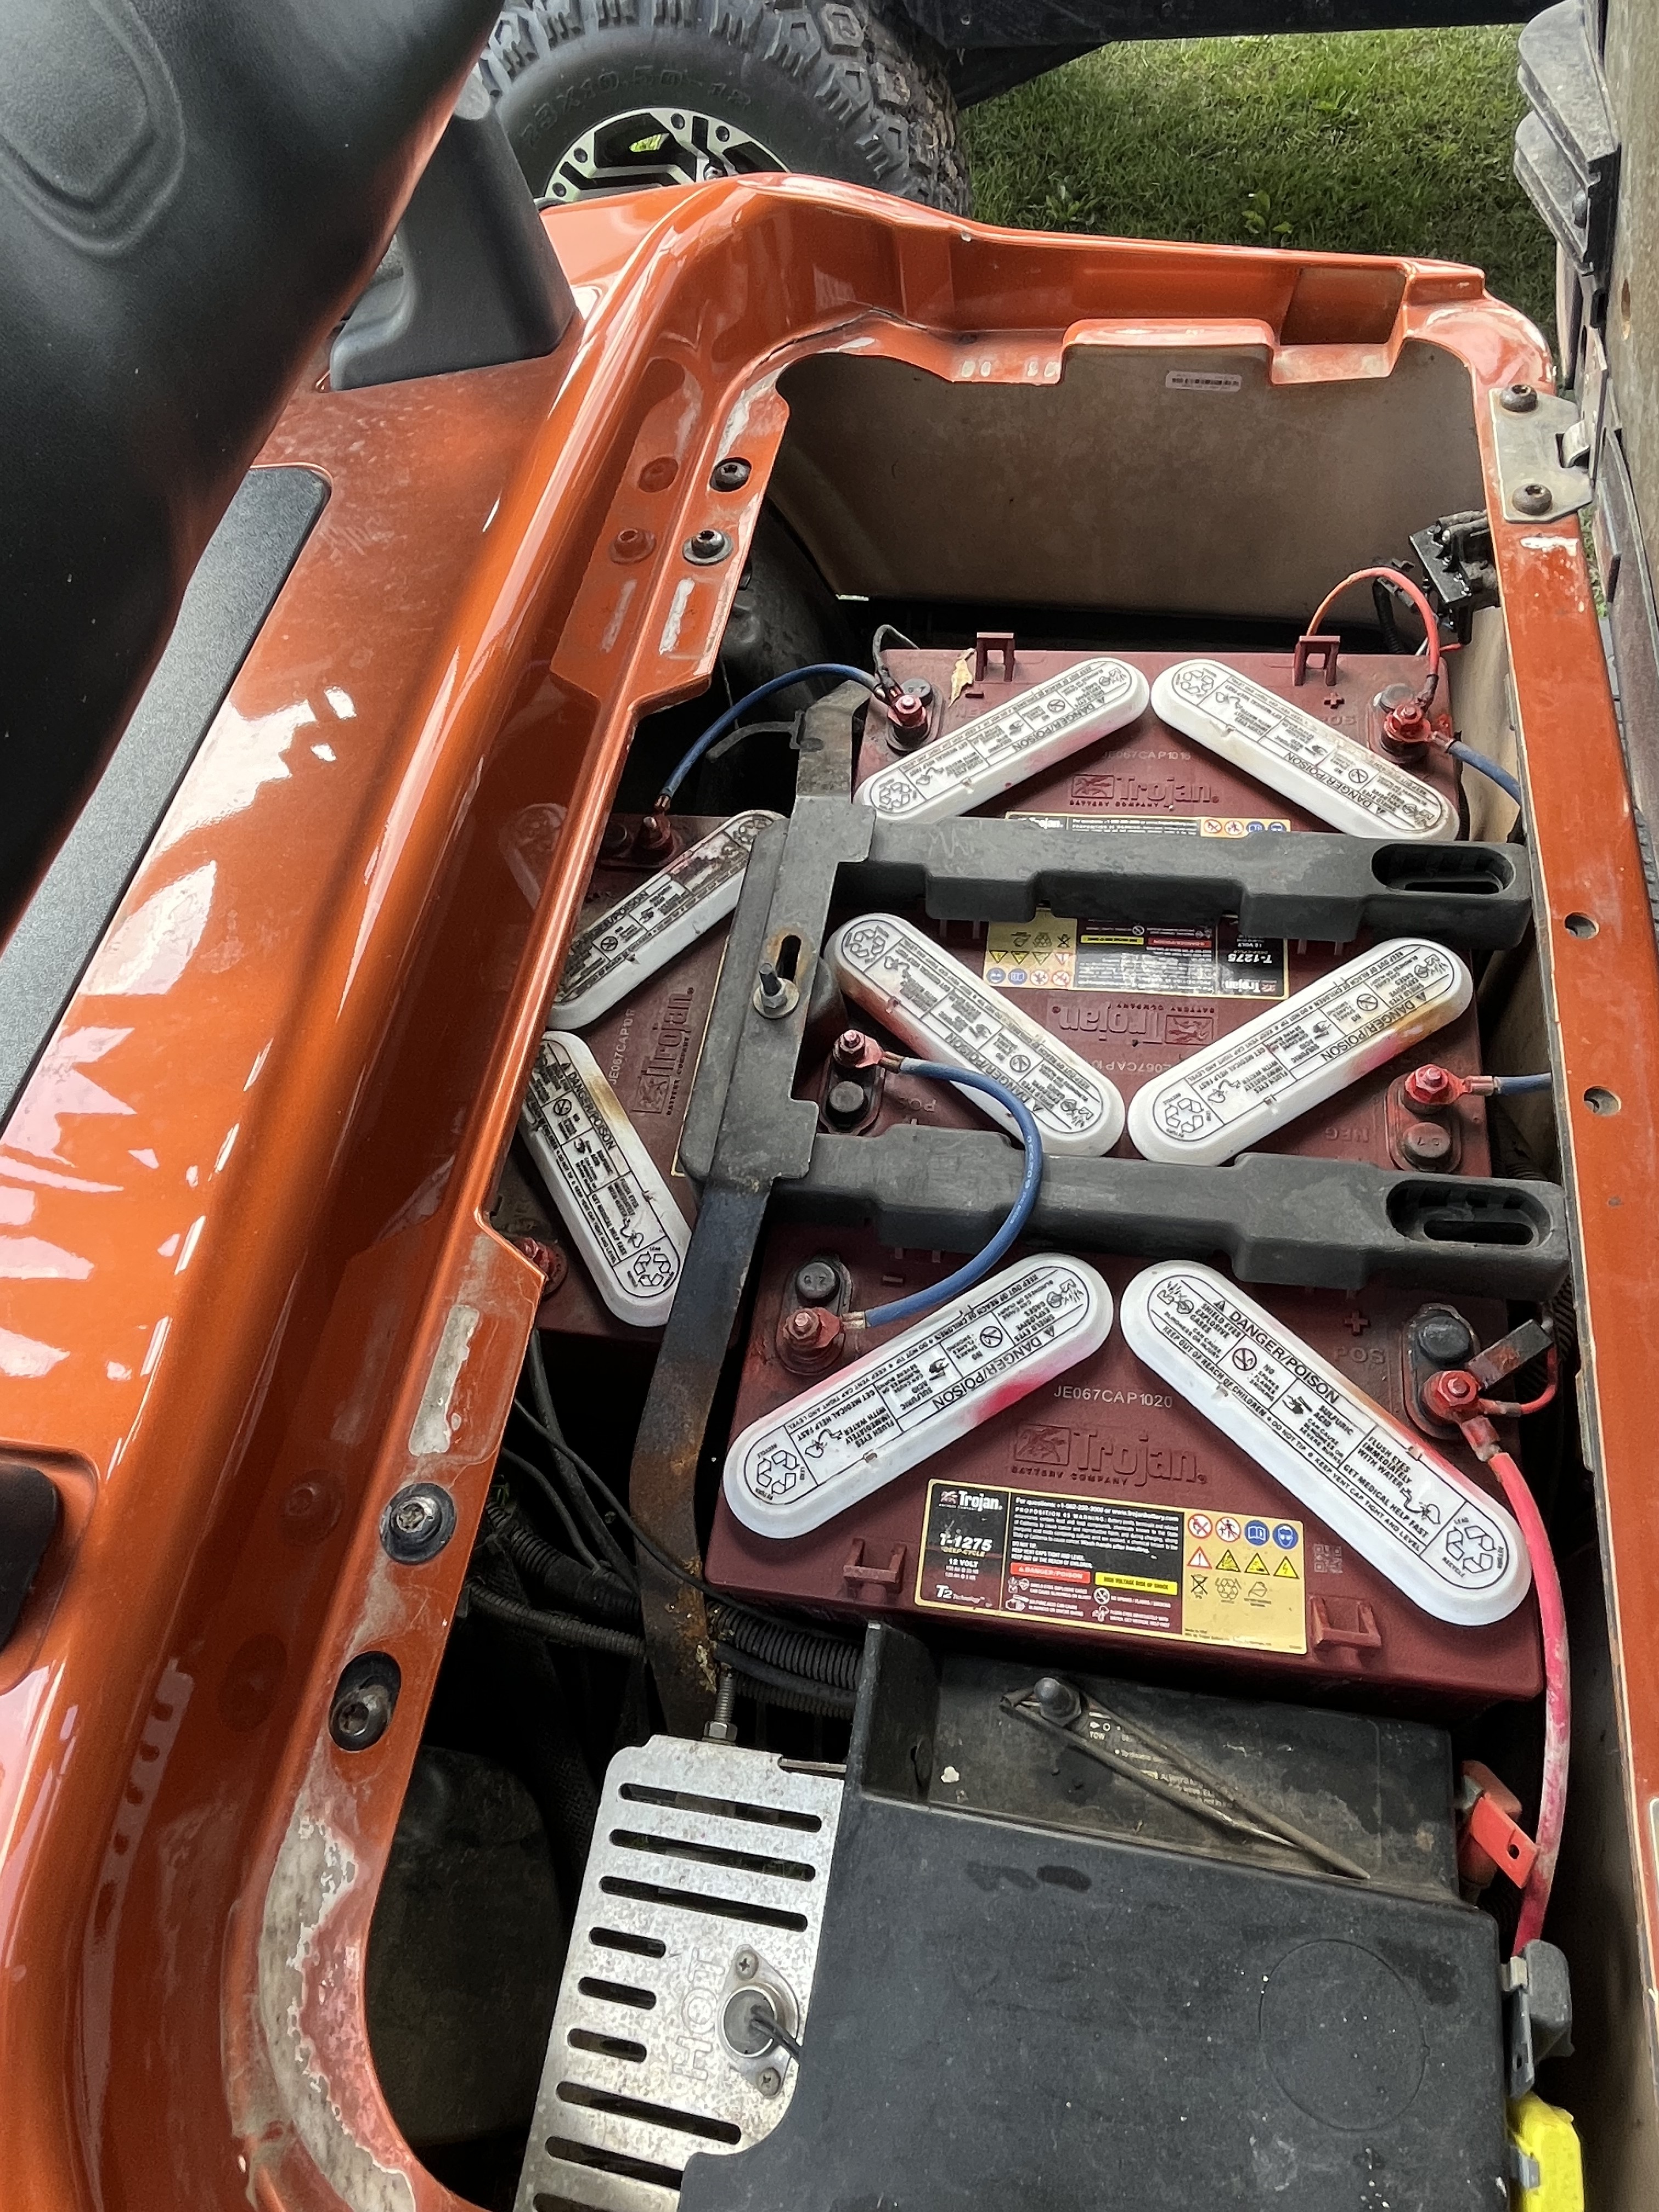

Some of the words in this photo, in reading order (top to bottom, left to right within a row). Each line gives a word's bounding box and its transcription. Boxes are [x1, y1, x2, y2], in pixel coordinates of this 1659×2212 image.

[1012, 701, 1094, 753] DANGER/POISON
[1283, 751, 1372, 809] DANGER/POISON
[1115, 774, 1211, 810] Trojan
[1228, 953, 1272, 963] T-1275
[1225, 978, 1260, 992] Trojan
[1059, 1000, 1163, 1044] Trojan
[1320, 999, 1415, 1062] DANGER/POISON
[643, 992, 692, 1077] Trojan
[664, 1079, 680, 1115] BATTERY
[675, 1037, 691, 1075] COMPANY
[566, 1070, 617, 1151] DANGER/POISON
[1325, 1126, 1369, 1143] NEG
[1007, 1283, 1023, 1296] OUT
[1021, 1273, 1039, 1288] KEEP
[976, 1297, 999, 1315] REACH
[998, 1292, 1009, 1302] OF
[967, 1311, 977, 1321] OF
[1015, 1306, 1051, 1331] EXPLOSIVE
[1023, 1300, 1046, 1318] GASES
[933, 1317, 968, 1341] CHILDREN
[1030, 1312, 1055, 1332] SHIELD
[1188, 1313, 1212, 1334] GASES
[1194, 1307, 1230, 1339] EXPLOSIVE
[1200, 1302, 1225, 1324] SHIELD
[1223, 1321, 1242, 1338] EYES
[1013, 1328, 1031, 1342] EYES
[905, 1347, 918, 1358] NOT
[918, 1341, 928, 1351] DO
[970, 1350, 983, 1361] NO
[1333, 1346, 1385, 1364] POS
[894, 1355, 905, 1365] TIP
[1228, 1309, 1340, 1404] DANGER/POISON
[869, 1367, 887, 1380] KEEP
[932, 1334, 1043, 1410] DANGER/POISON
[1262, 1363, 1276, 1376] NO
[853, 1376, 870, 1390] VENT
[910, 1379, 928, 1394] ACID
[1248, 1378, 1276, 1402] SMOKING
[1253, 1374, 1276, 1395] FLAMES
[1257, 1370, 1280, 1390] SPARKS
[821, 1395, 840, 1409] TIGHT
[840, 1386, 854, 1398] CAP
[861, 1388, 876, 1401] GET
[899, 1386, 933, 1411] SULFURIC
[1053, 1385, 1173, 1408] JE067CAP1020
[807, 1407, 822, 1418] AND
[831, 1396, 862, 1419] MEDICAL
[866, 1405, 887, 1421] WITH
[787, 1415, 808, 1430] LEVEL
[812, 1415, 832, 1430] HELP
[843, 1417, 867, 1436] WATER
[843, 1412, 891, 1445] IMMEDIATELY
[871, 1419, 895, 1437] FLUSH
[1312, 1410, 1332, 1428] ACID
[1318, 1404, 1355, 1436] SULFURIC
[795, 1426, 814, 1441] FAST
[854, 1432, 872, 1448] EYES
[1161, 1324, 1181, 1342] KEEP
[1177, 1339, 1193, 1353] OUT
[1191, 1350, 1203, 1361] OF
[1199, 1358, 1224, 1380] REACH
[1221, 1377, 1233, 1389] OF
[1231, 1385, 1268, 1418] CHILDREN
[1271, 1420, 1283, 1431] DO
[1280, 1429, 1296, 1443] NOT
[1295, 1441, 1307, 1452] TIP
[1314, 1457, 1333, 1474] KEEP
[1331, 1472, 1350, 1489] VENT
[1348, 1487, 1364, 1502] CAP
[1363, 1499, 1385, 1519] TIGHT
[1384, 1517, 1400, 1532] AND
[1398, 1530, 1423, 1551] LEVEL
[1306, 1417, 1321, 1430] CAN
[1319, 1428, 1340, 1446] CAUSE
[1073, 1429, 1198, 1487] Trojan
[1361, 1441, 1413, 1485] IMMEDIATELY
[1367, 1435, 1393, 1458] FLUSH
[1390, 1454, 1411, 1474] EYES
[1012, 1465, 1063, 1479] BATTERY
[1071, 1472, 1128, 1486] COMPANY
[1356, 1447, 1378, 1467] WITH
[1376, 1464, 1404, 1489] WATER
[957, 1490, 1001, 1514] Trojan
[1342, 1463, 1359, 1479] GET
[1356, 1475, 1391, 1506] MEDICAL
[1389, 1503, 1410, 1523] HELP
[1408, 1519, 1429, 1538] FAST
[938, 1532, 993, 1552] T-1275
[948, 1557, 958, 1566] 12
[959, 1559, 979, 1568] VOLT
[1441, 1556, 1466, 1578] RECYCLE
[1090, 1731, 1105, 1740] TOW
[671, 1948, 726, 2081] HOT
